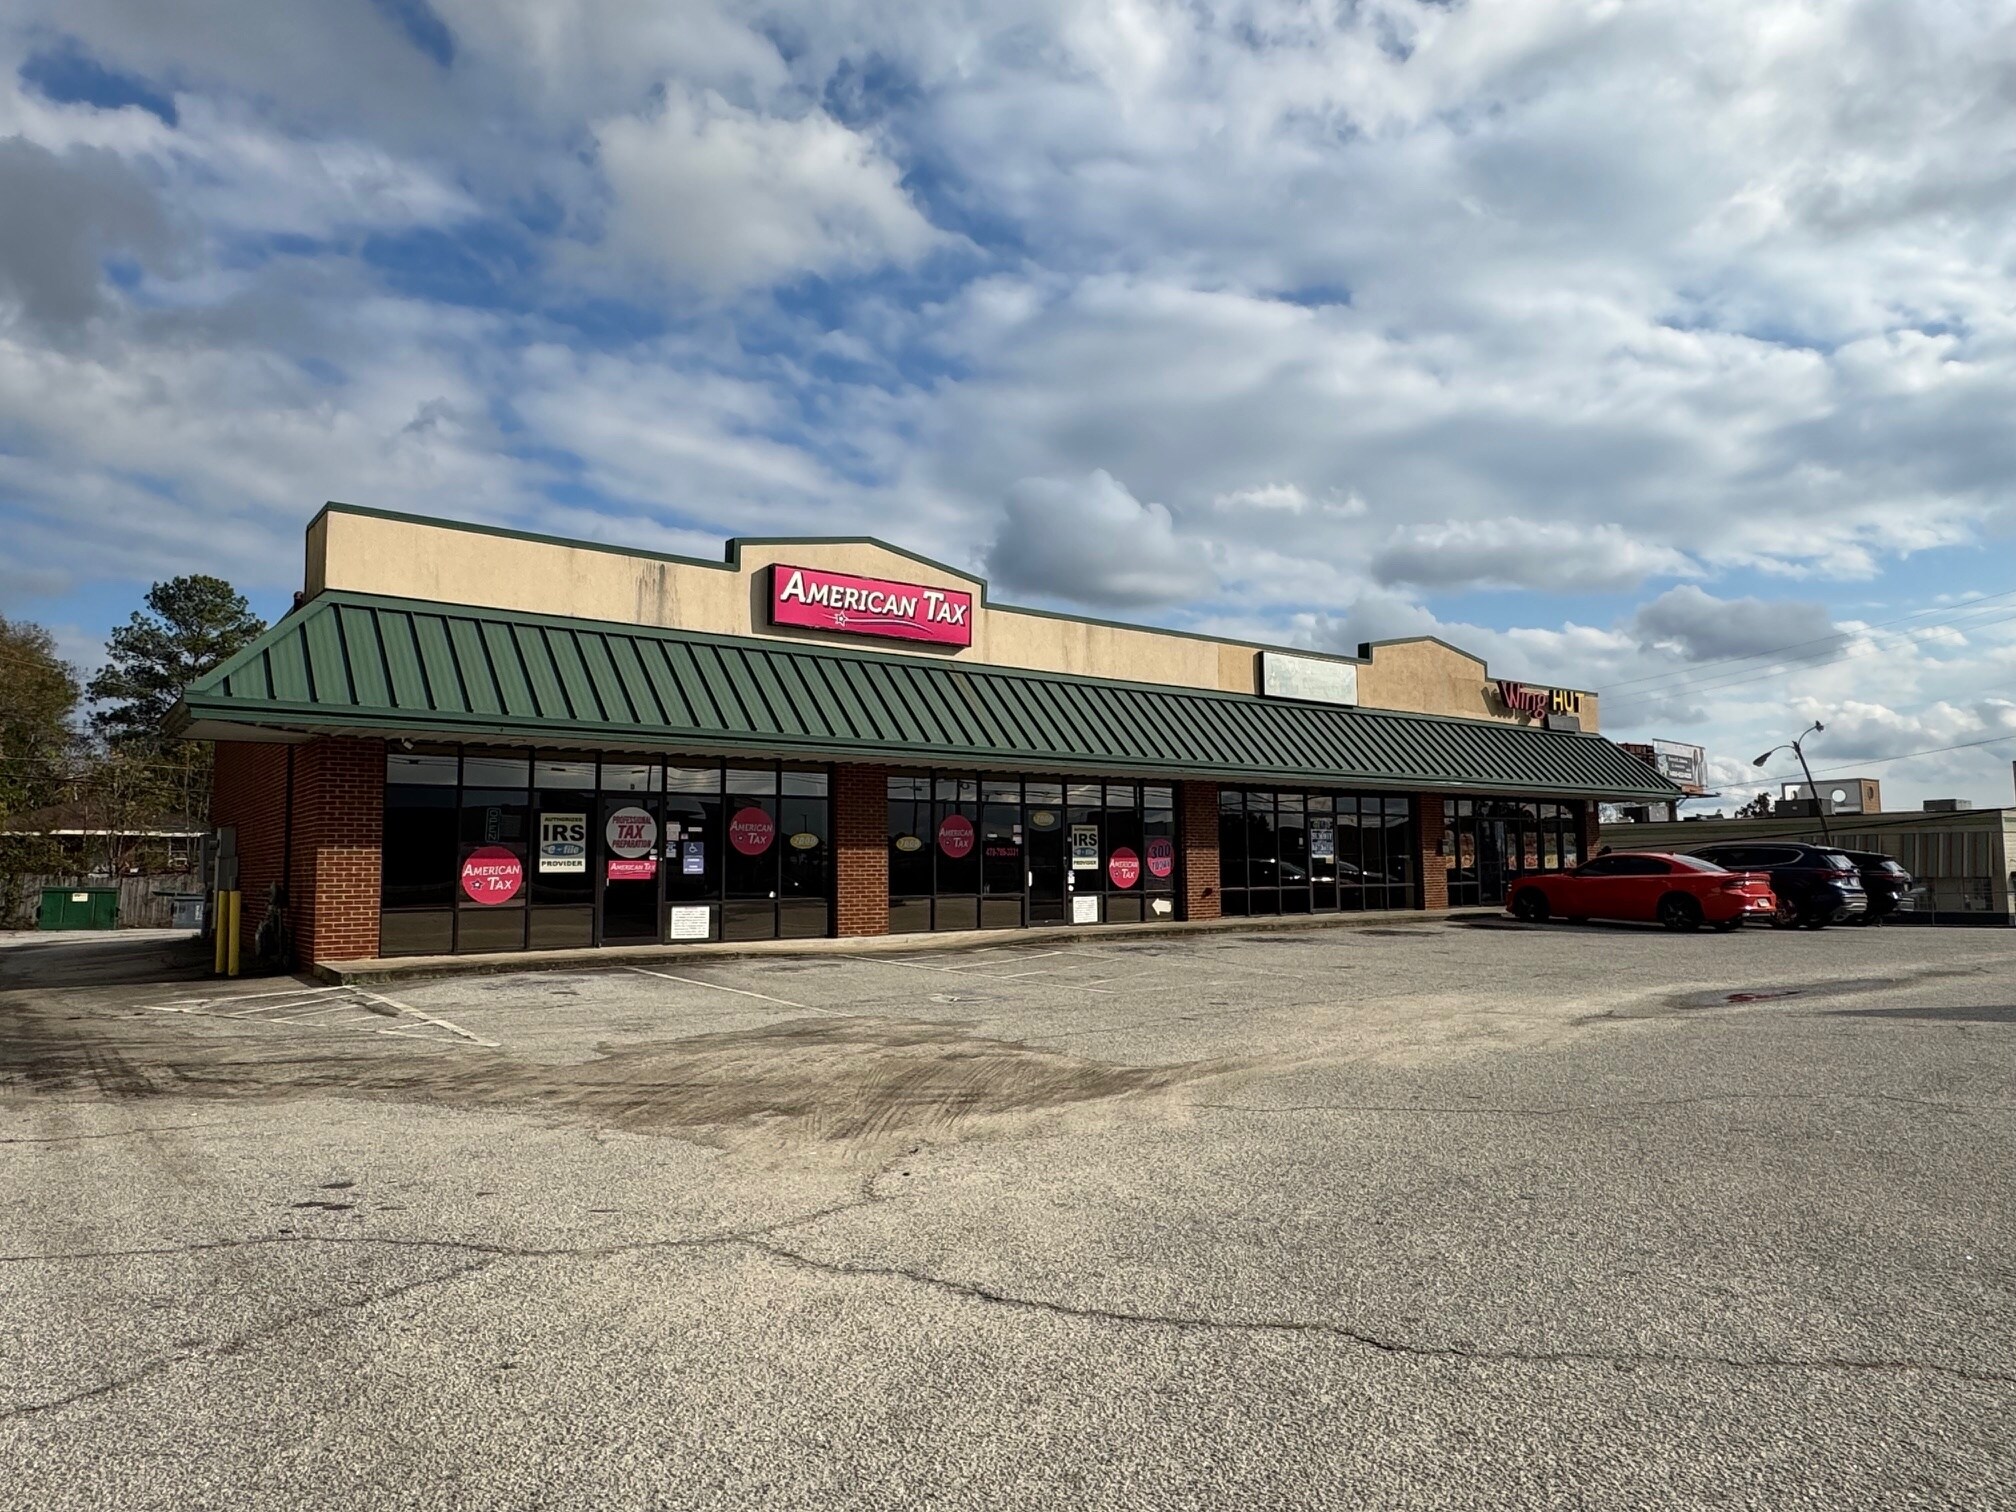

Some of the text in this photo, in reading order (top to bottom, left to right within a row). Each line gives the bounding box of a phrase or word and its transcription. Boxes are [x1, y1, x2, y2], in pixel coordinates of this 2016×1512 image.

[780, 570, 967, 626] AMERICAN TAX
[1496, 680, 1585, 720] Wing HUT
[487, 809, 499, 841] OPEN
[612, 815, 652, 825] PROFESSIONAL
[730, 820, 774, 832] AMERICAN
[543, 824, 585, 842] IRS
[617, 824, 645, 839] TAX
[938, 827, 974, 837] AMERICAN
[612, 839, 652, 849] PREPARATION
[747, 832, 768, 845] TAX
[953, 837, 969, 848] TAX
[1073, 833, 1098, 847] IRS
[1151, 843, 1171, 858] 300
[610, 862, 644, 871] AMERICAN
[1109, 857, 1139, 868] AMERICAN
[463, 864, 521, 877] AMERICAN
[1121, 869, 1136, 879] TAX
[487, 876, 513, 891] TAX
